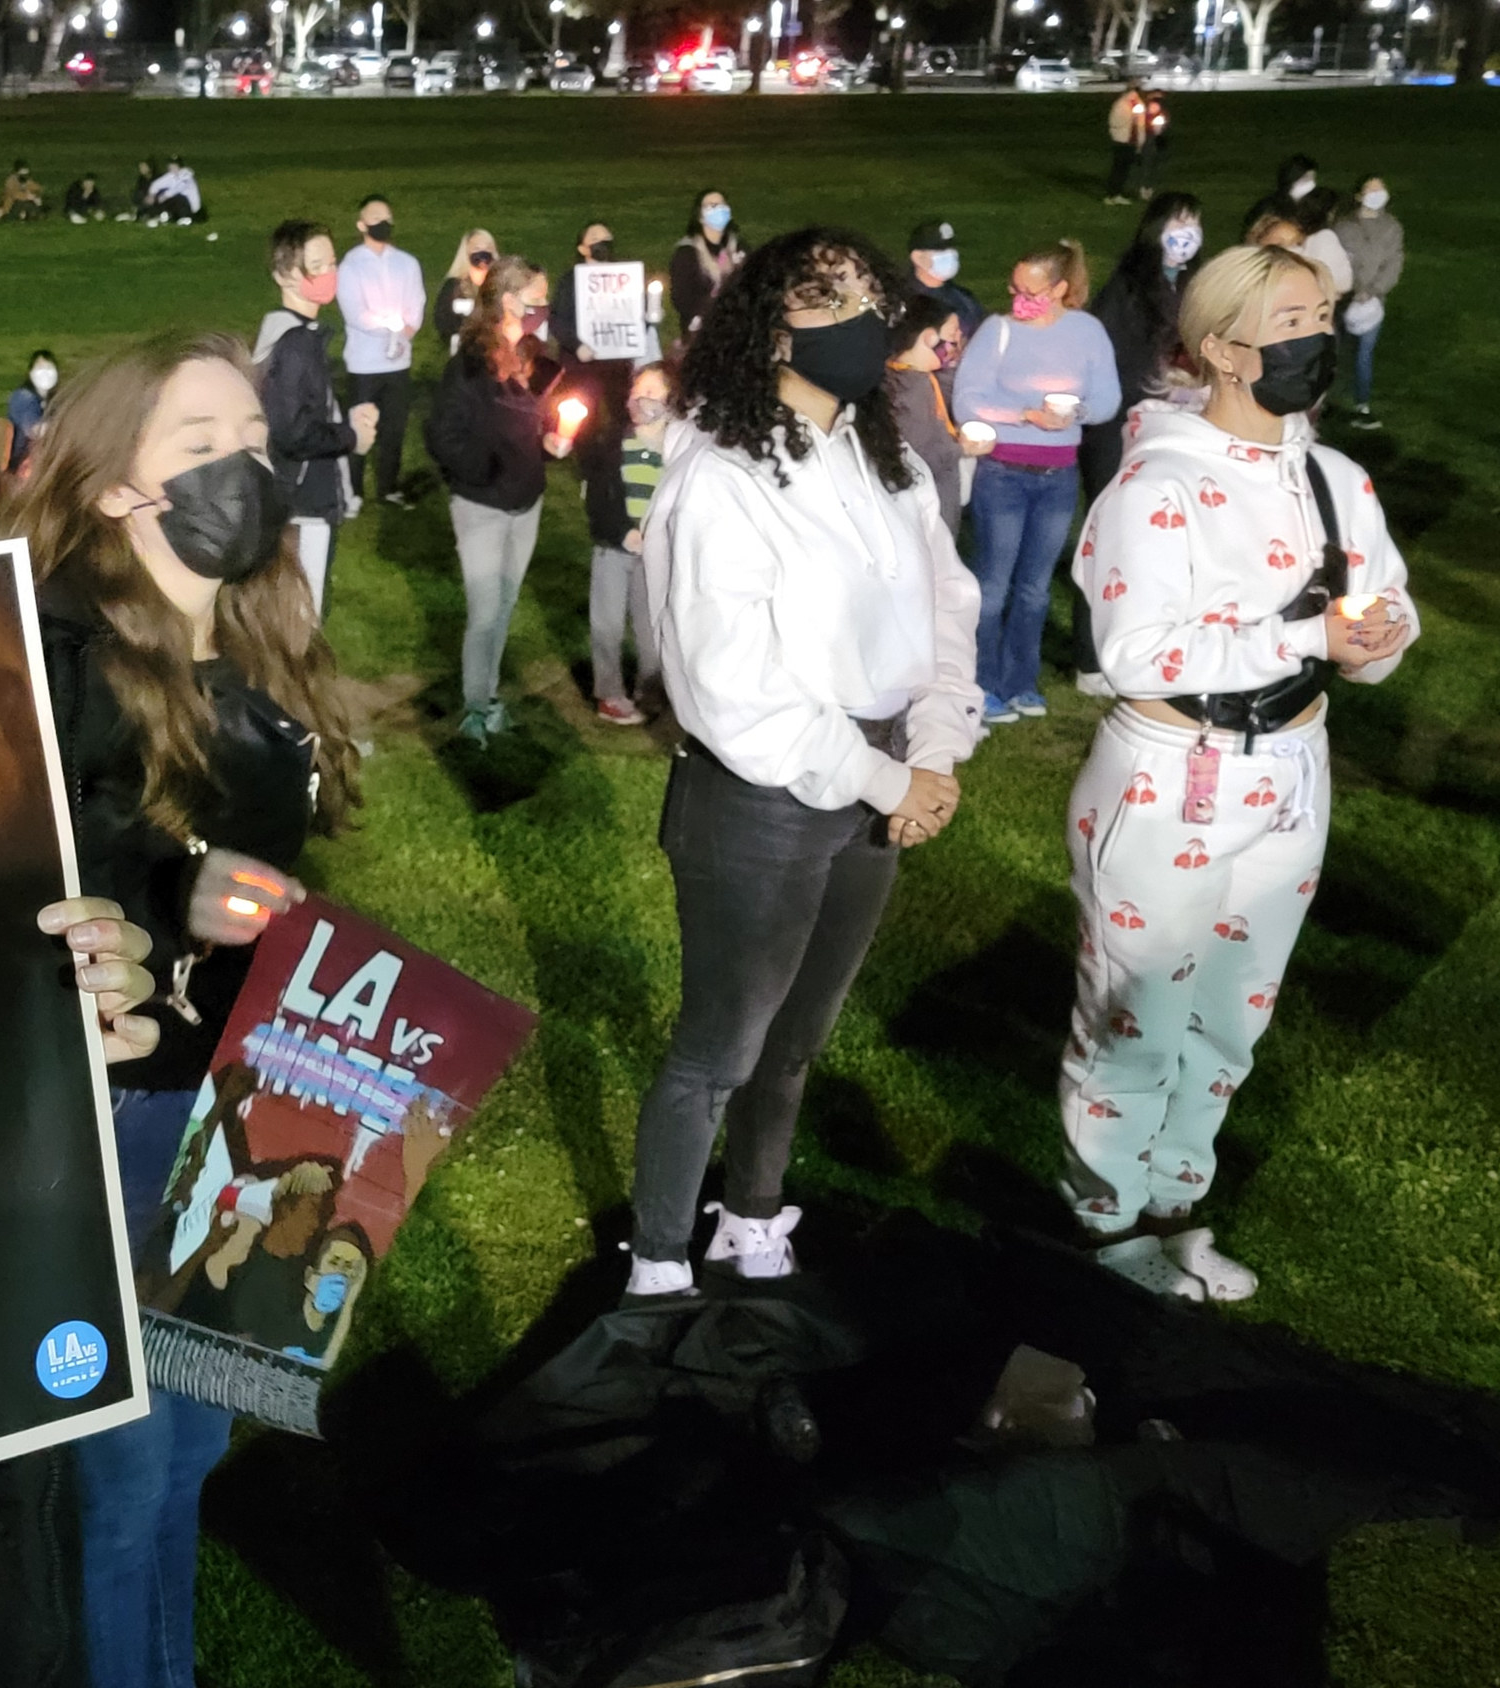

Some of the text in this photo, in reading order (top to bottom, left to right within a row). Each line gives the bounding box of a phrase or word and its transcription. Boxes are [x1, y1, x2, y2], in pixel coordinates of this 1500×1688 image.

[588, 272, 630, 294] STOP
[592, 321, 638, 347] HATE
[281, 917, 404, 1041] LA
[47, 1332, 84, 1367] LA
